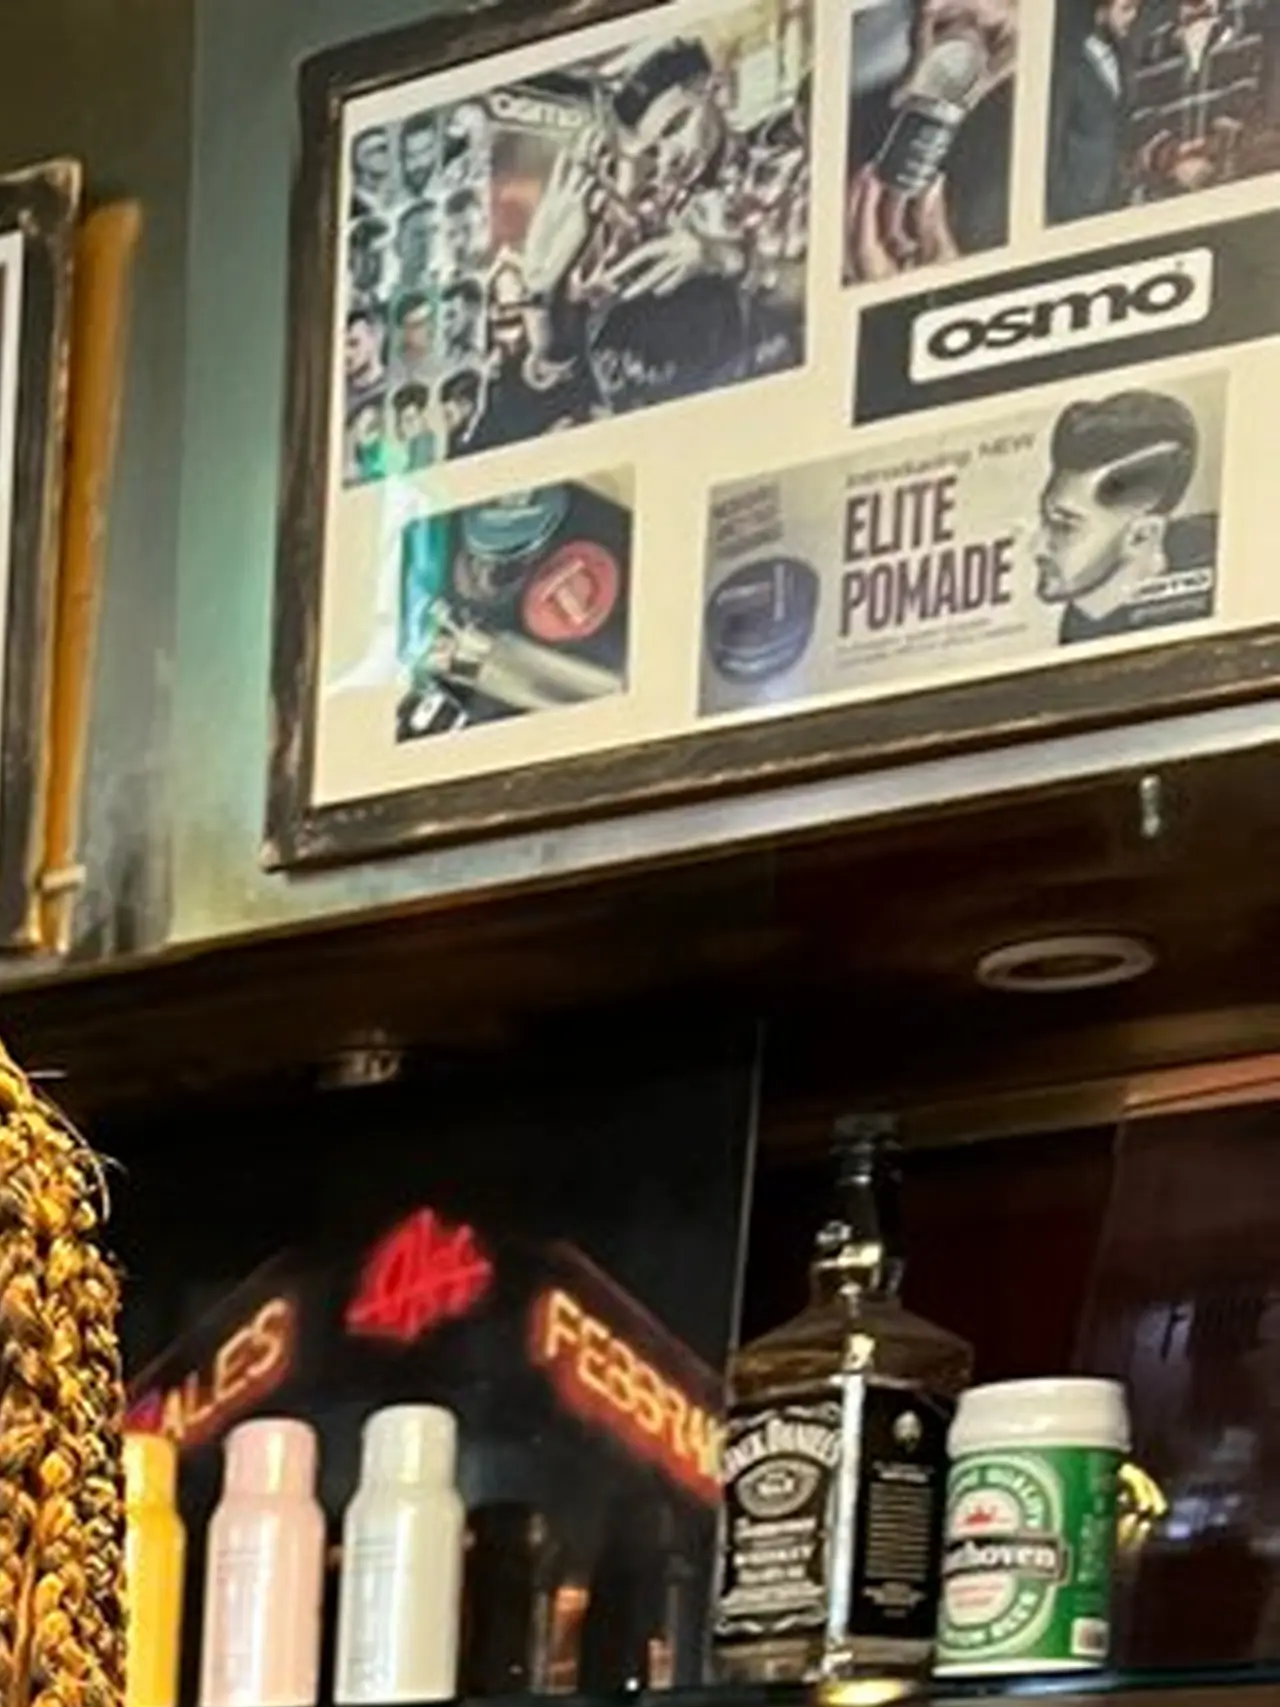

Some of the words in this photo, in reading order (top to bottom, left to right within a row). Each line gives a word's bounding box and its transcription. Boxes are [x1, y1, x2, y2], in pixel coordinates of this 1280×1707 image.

[926, 272, 1196, 361] osmo
[843, 473, 958, 564] ELITE
[839, 535, 1016, 640] POMADE
